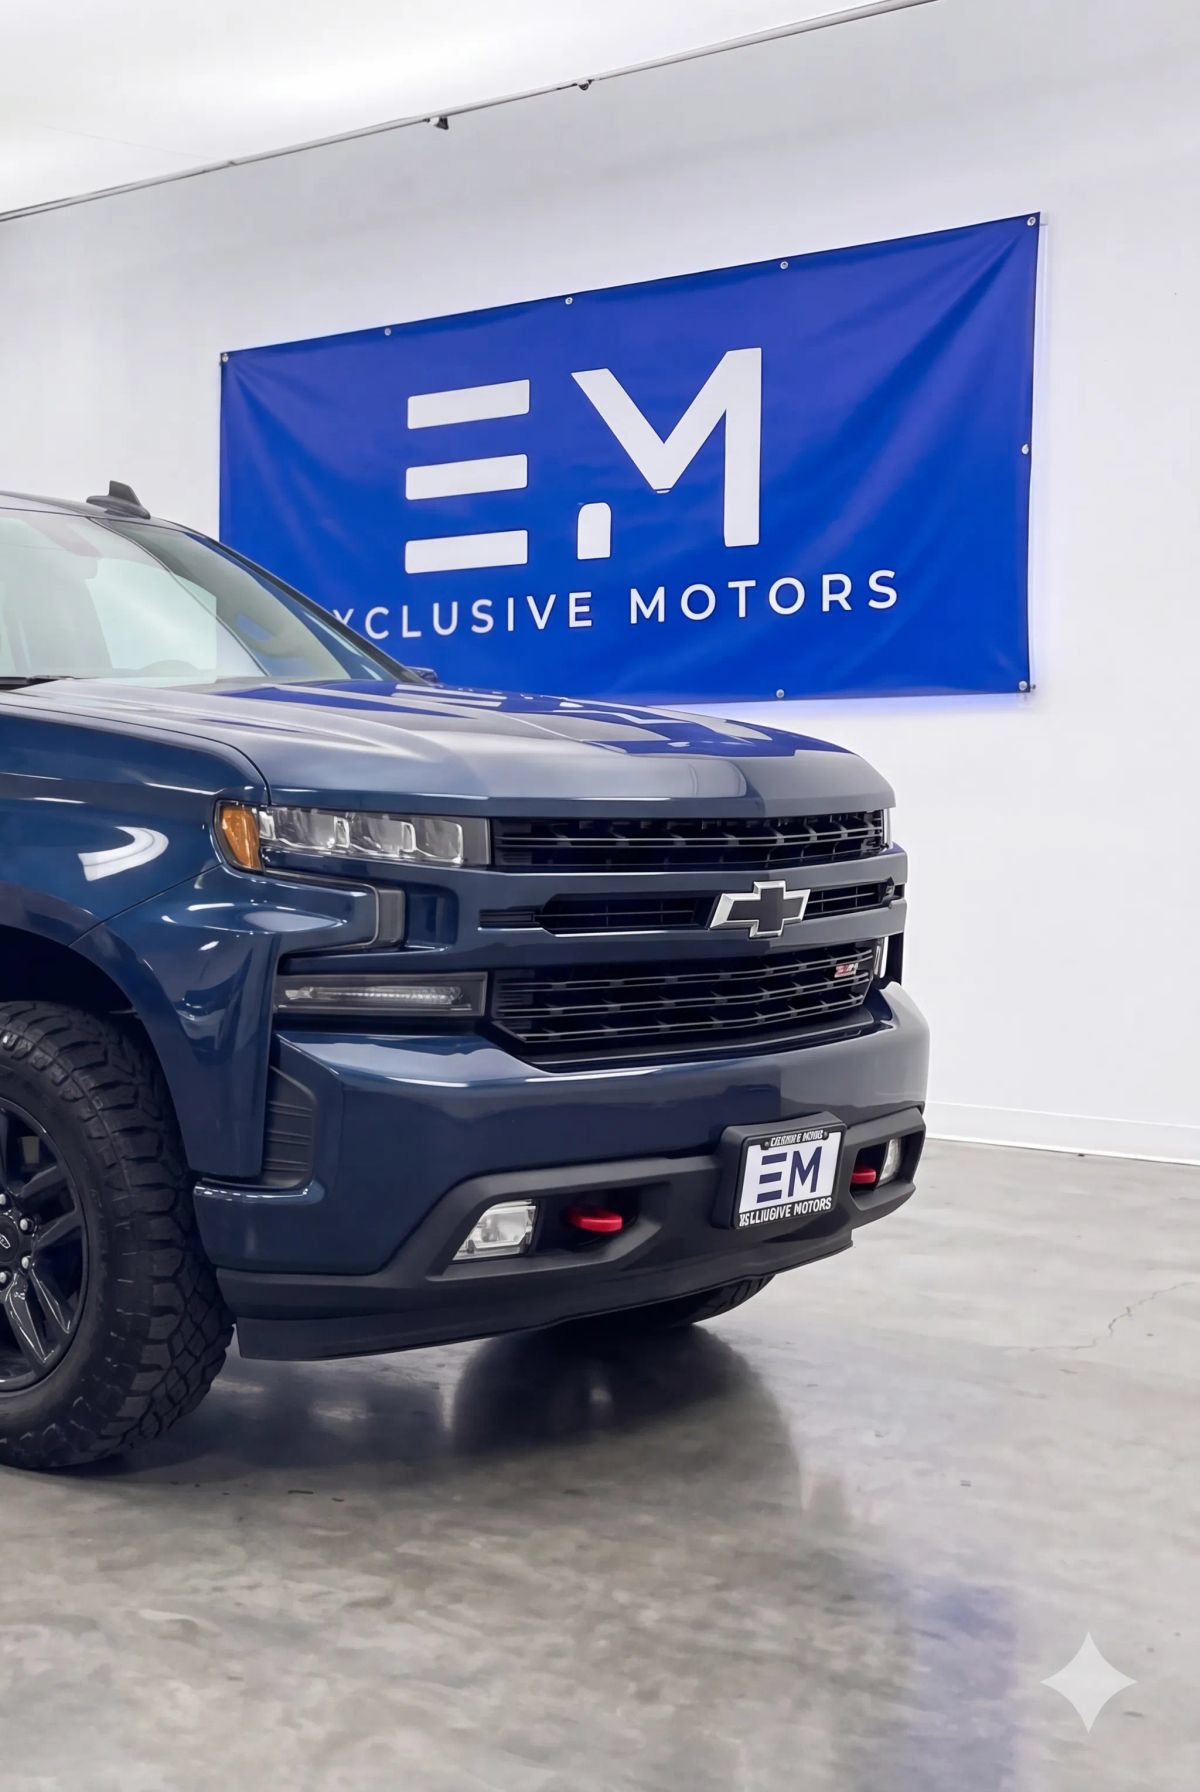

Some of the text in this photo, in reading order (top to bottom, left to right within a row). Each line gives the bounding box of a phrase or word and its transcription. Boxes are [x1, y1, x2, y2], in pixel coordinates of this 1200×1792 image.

[405, 347, 761, 574] EM
[629, 569, 898, 624] MOTORS
[756, 1146, 822, 1204] EM
[793, 1197, 832, 1216] MOTORS
